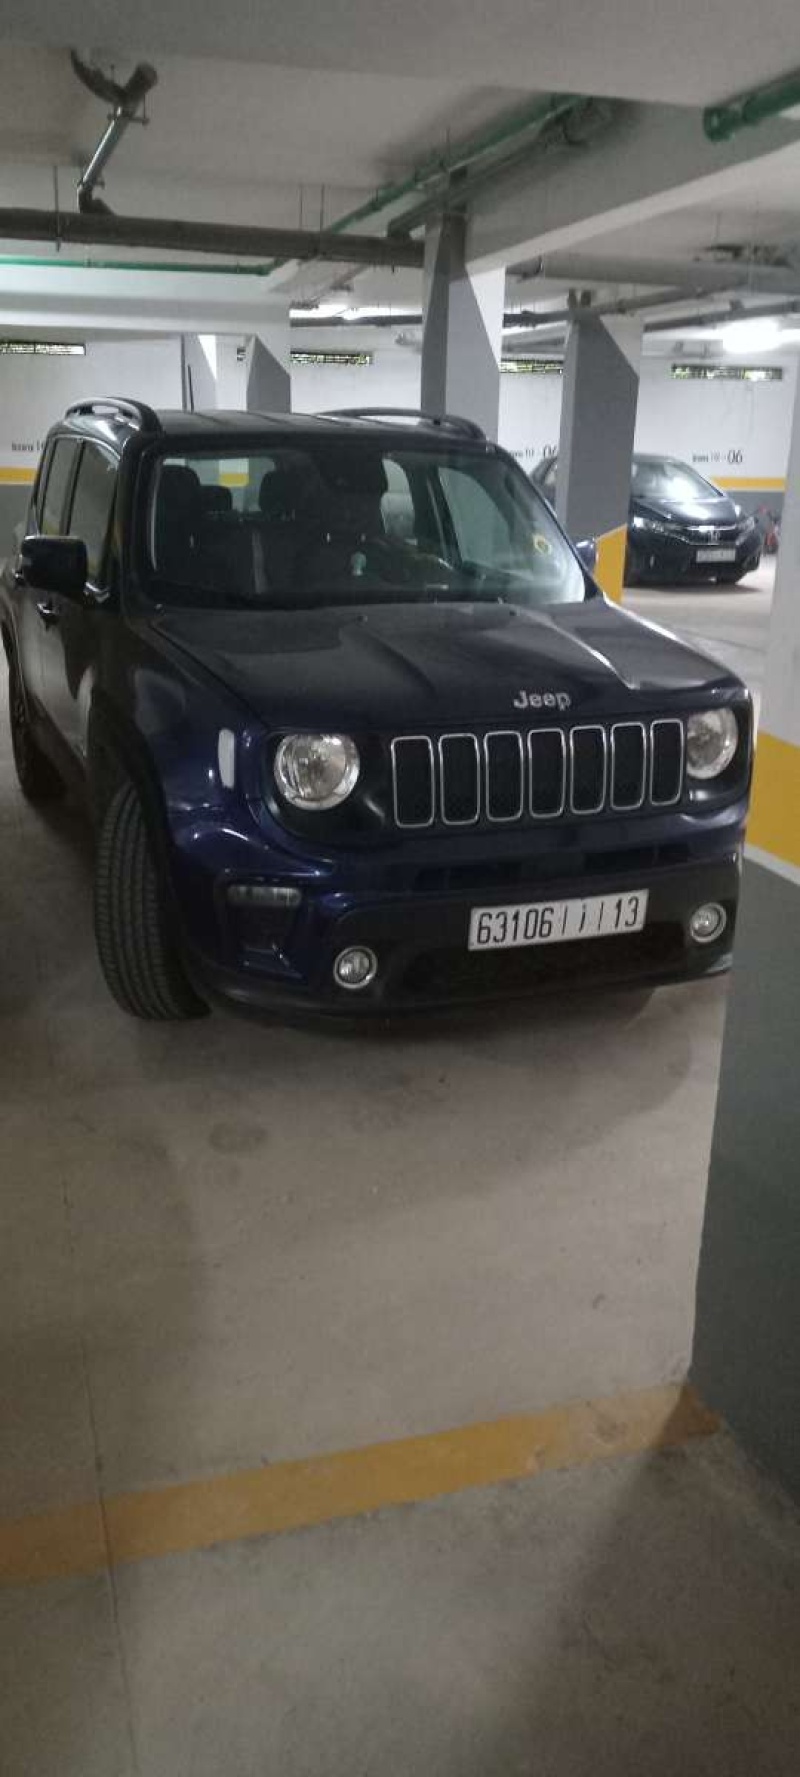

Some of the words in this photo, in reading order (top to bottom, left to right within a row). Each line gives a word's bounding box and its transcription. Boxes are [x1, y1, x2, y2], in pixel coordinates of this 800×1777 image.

[513, 689, 571, 711] Jeep
[476, 907, 555, 944] 63106
[615, 896, 639, 928] 13
